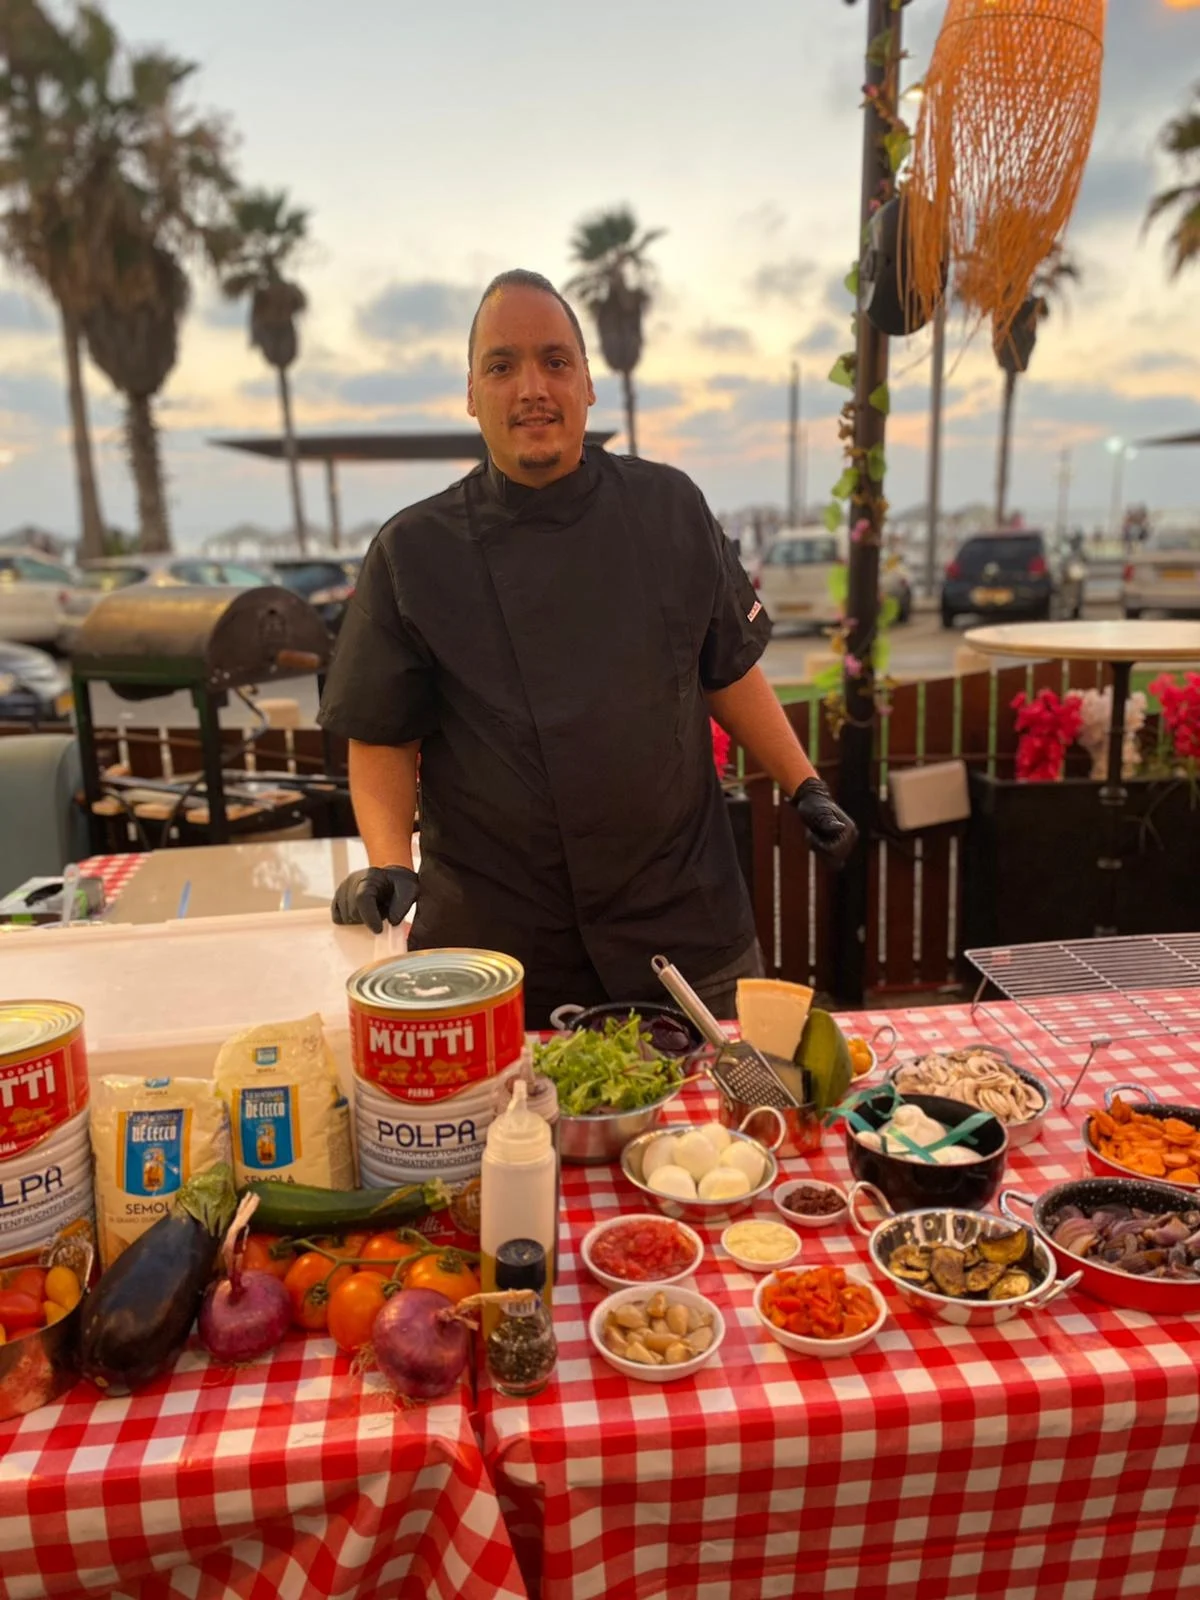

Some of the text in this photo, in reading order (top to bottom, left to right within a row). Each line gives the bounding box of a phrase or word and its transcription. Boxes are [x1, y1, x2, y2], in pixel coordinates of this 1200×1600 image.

[369, 1025, 474, 1058] MUTTI
[407, 1087, 435, 1099] PARMA
[377, 1119, 476, 1148] POLPA
